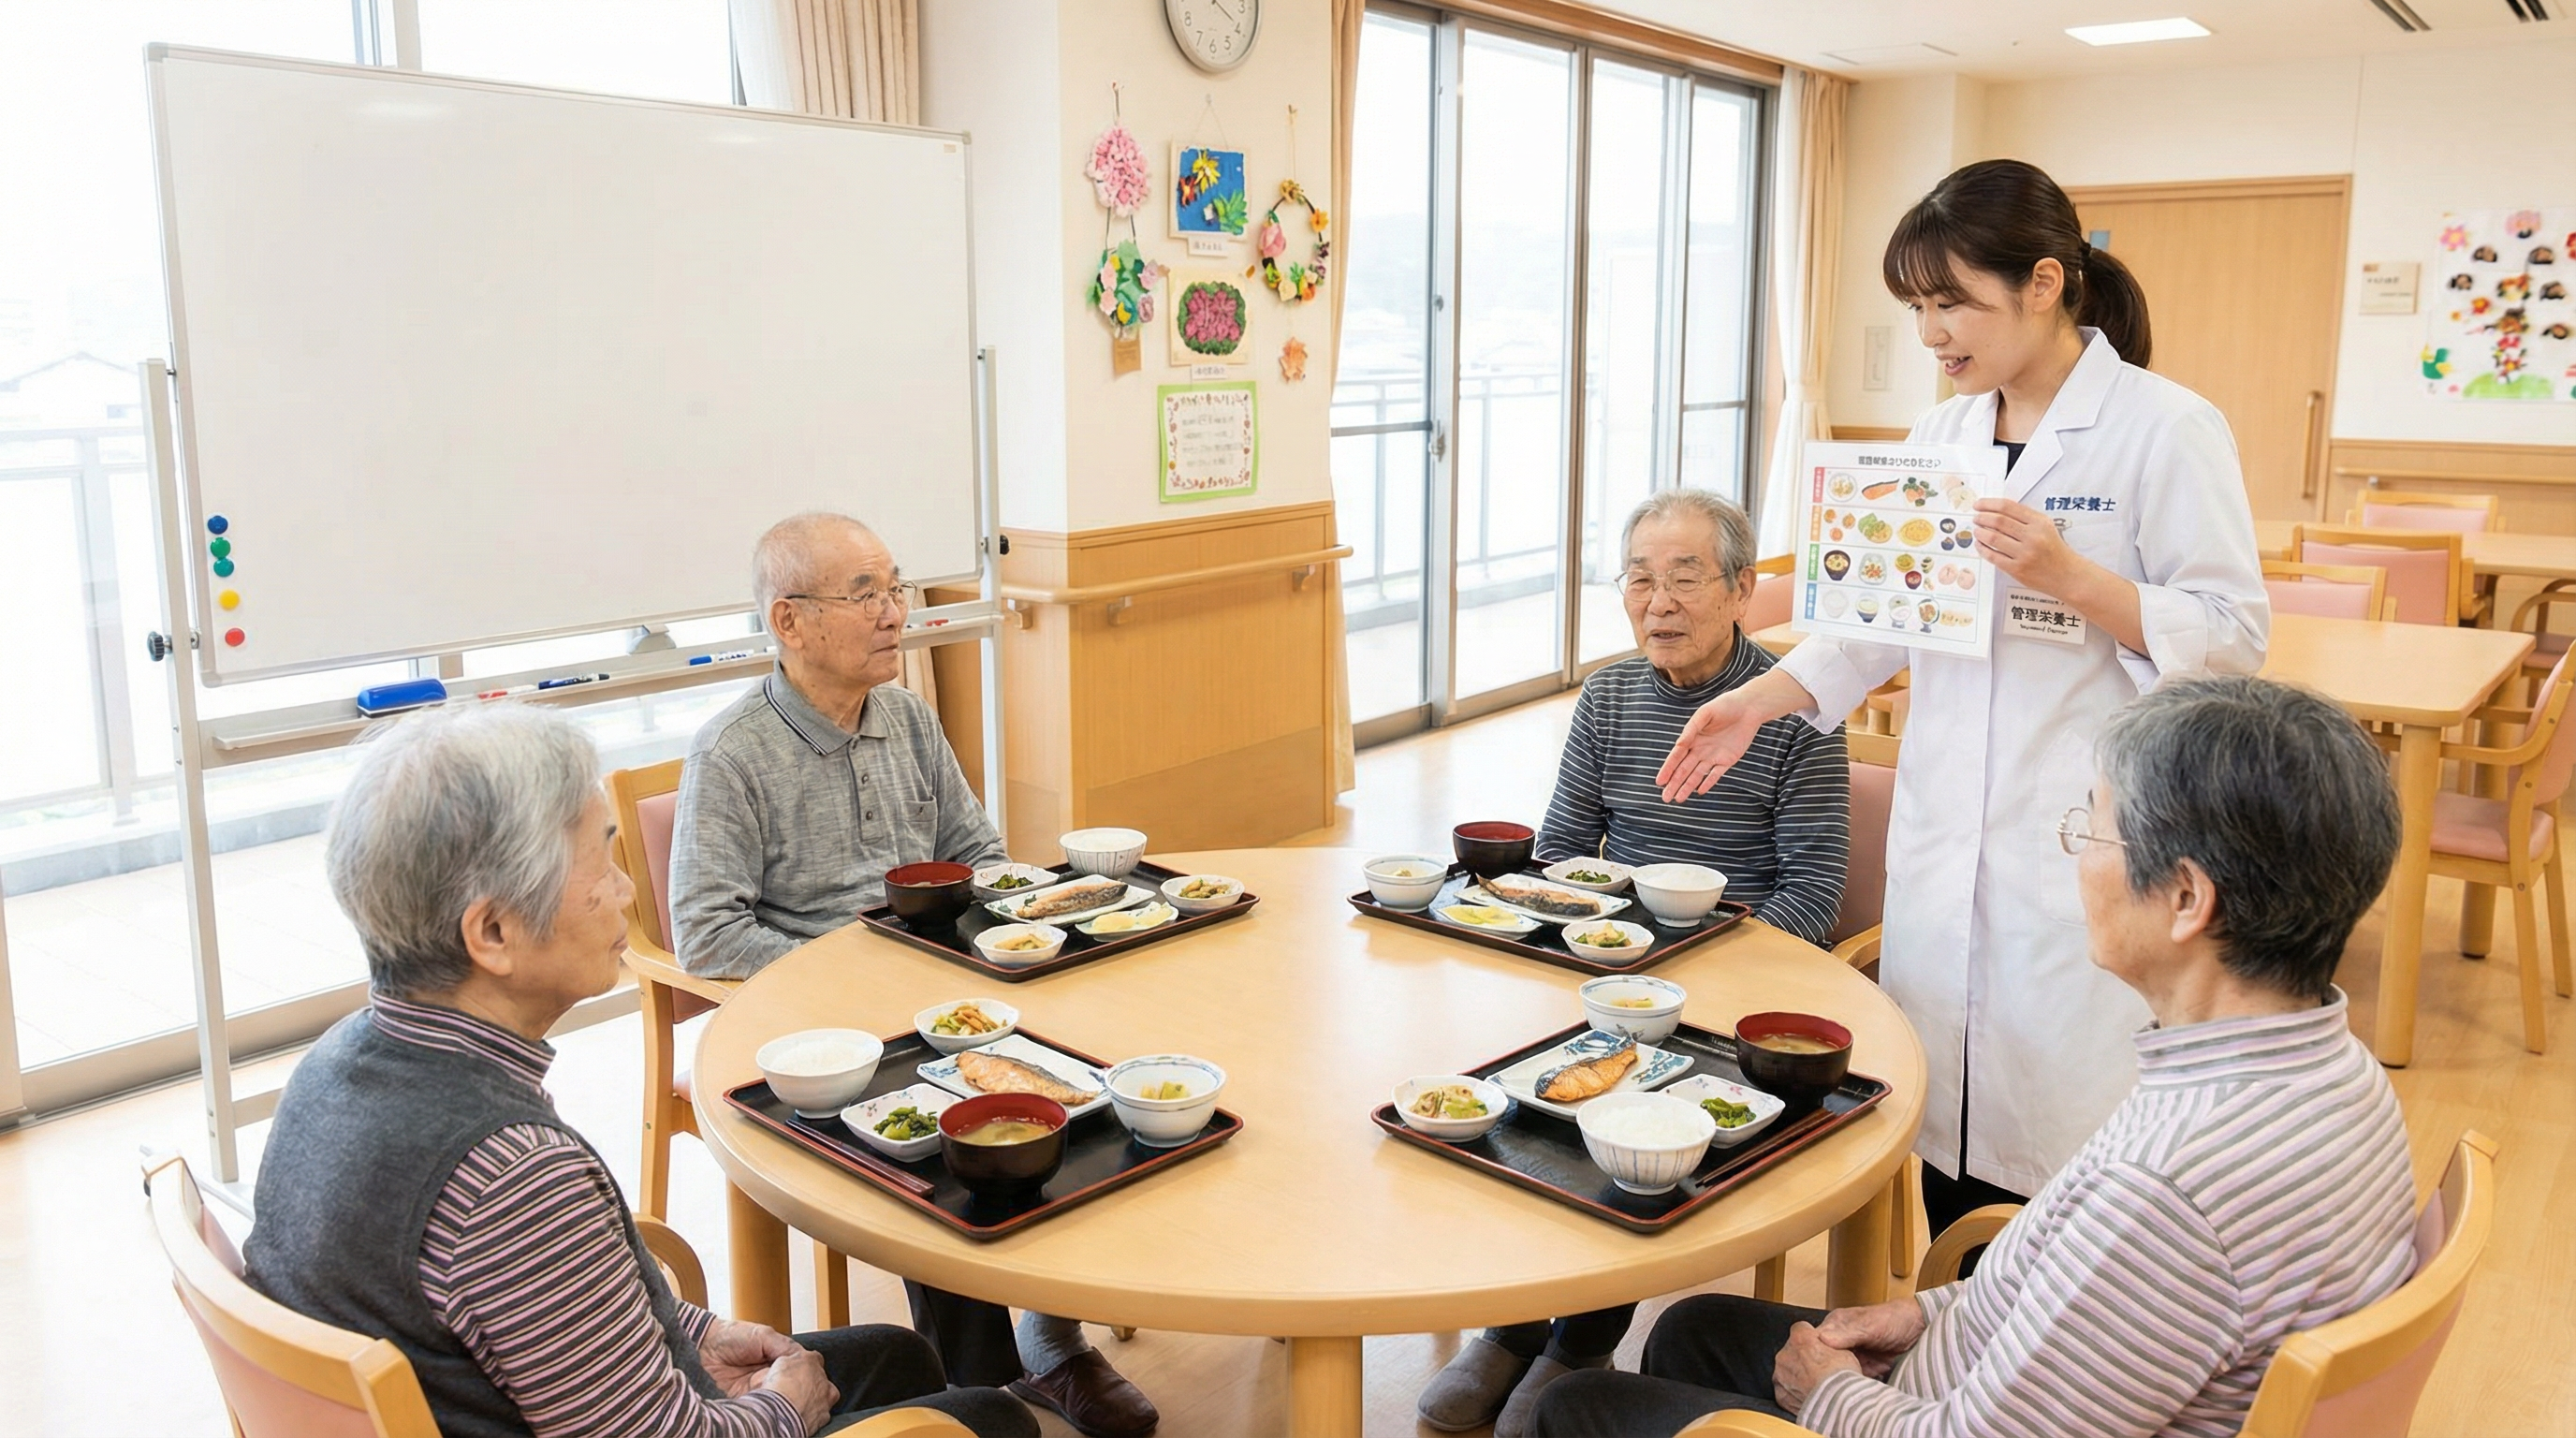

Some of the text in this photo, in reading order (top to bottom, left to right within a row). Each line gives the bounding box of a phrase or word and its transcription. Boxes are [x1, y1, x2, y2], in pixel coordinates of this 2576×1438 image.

[1185, 11, 1192, 26] 8
[1196, 31, 1203, 46] 7
[1224, 37, 1231, 50] 5
[1209, 39, 1216, 53] 6
